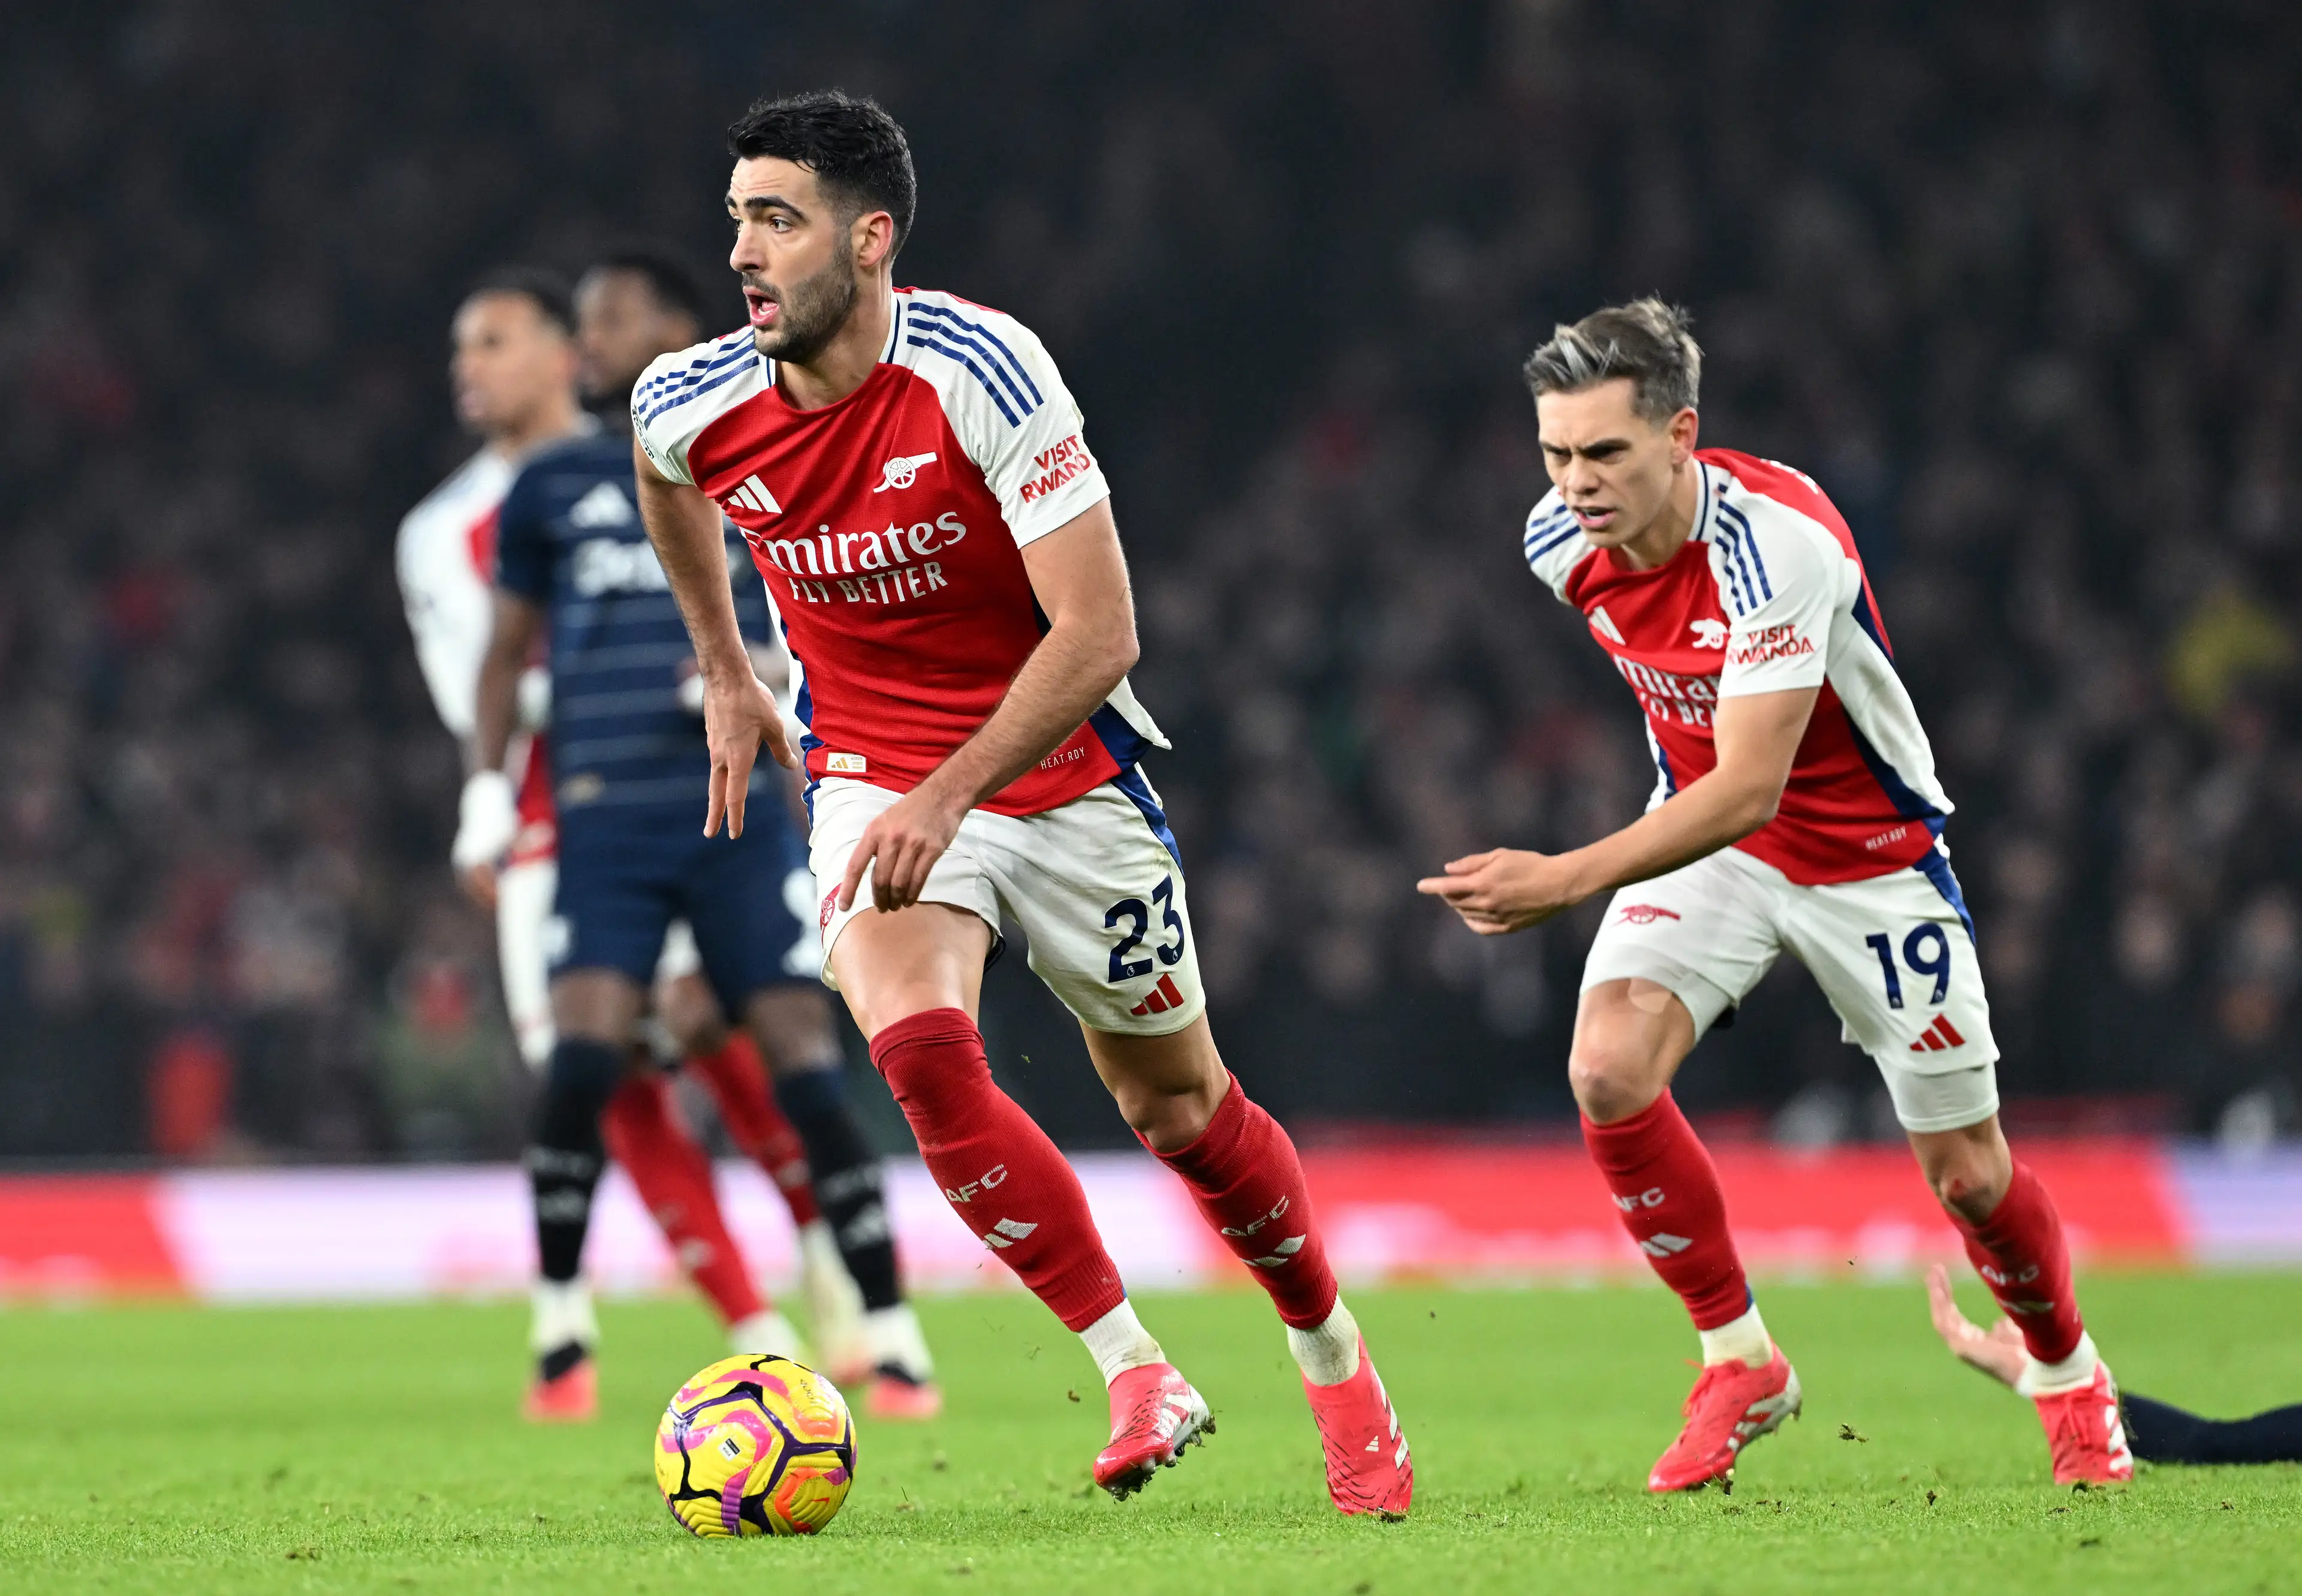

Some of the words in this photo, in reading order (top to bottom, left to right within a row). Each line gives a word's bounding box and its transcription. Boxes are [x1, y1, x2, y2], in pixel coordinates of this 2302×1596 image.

[1034, 434, 1079, 471] VISIT
[1020, 453, 1090, 504] RWAND
[788, 576, 830, 603] FLY
[836, 561, 948, 604] BETTER
[1747, 624, 1796, 645] VISIT
[1040, 746, 1084, 770] HEAT.RDY
[1104, 872, 1185, 983] 23
[1866, 922, 1951, 1008] 19
[945, 1163, 1008, 1202] AFC
[1221, 1195, 1289, 1236] AFC
